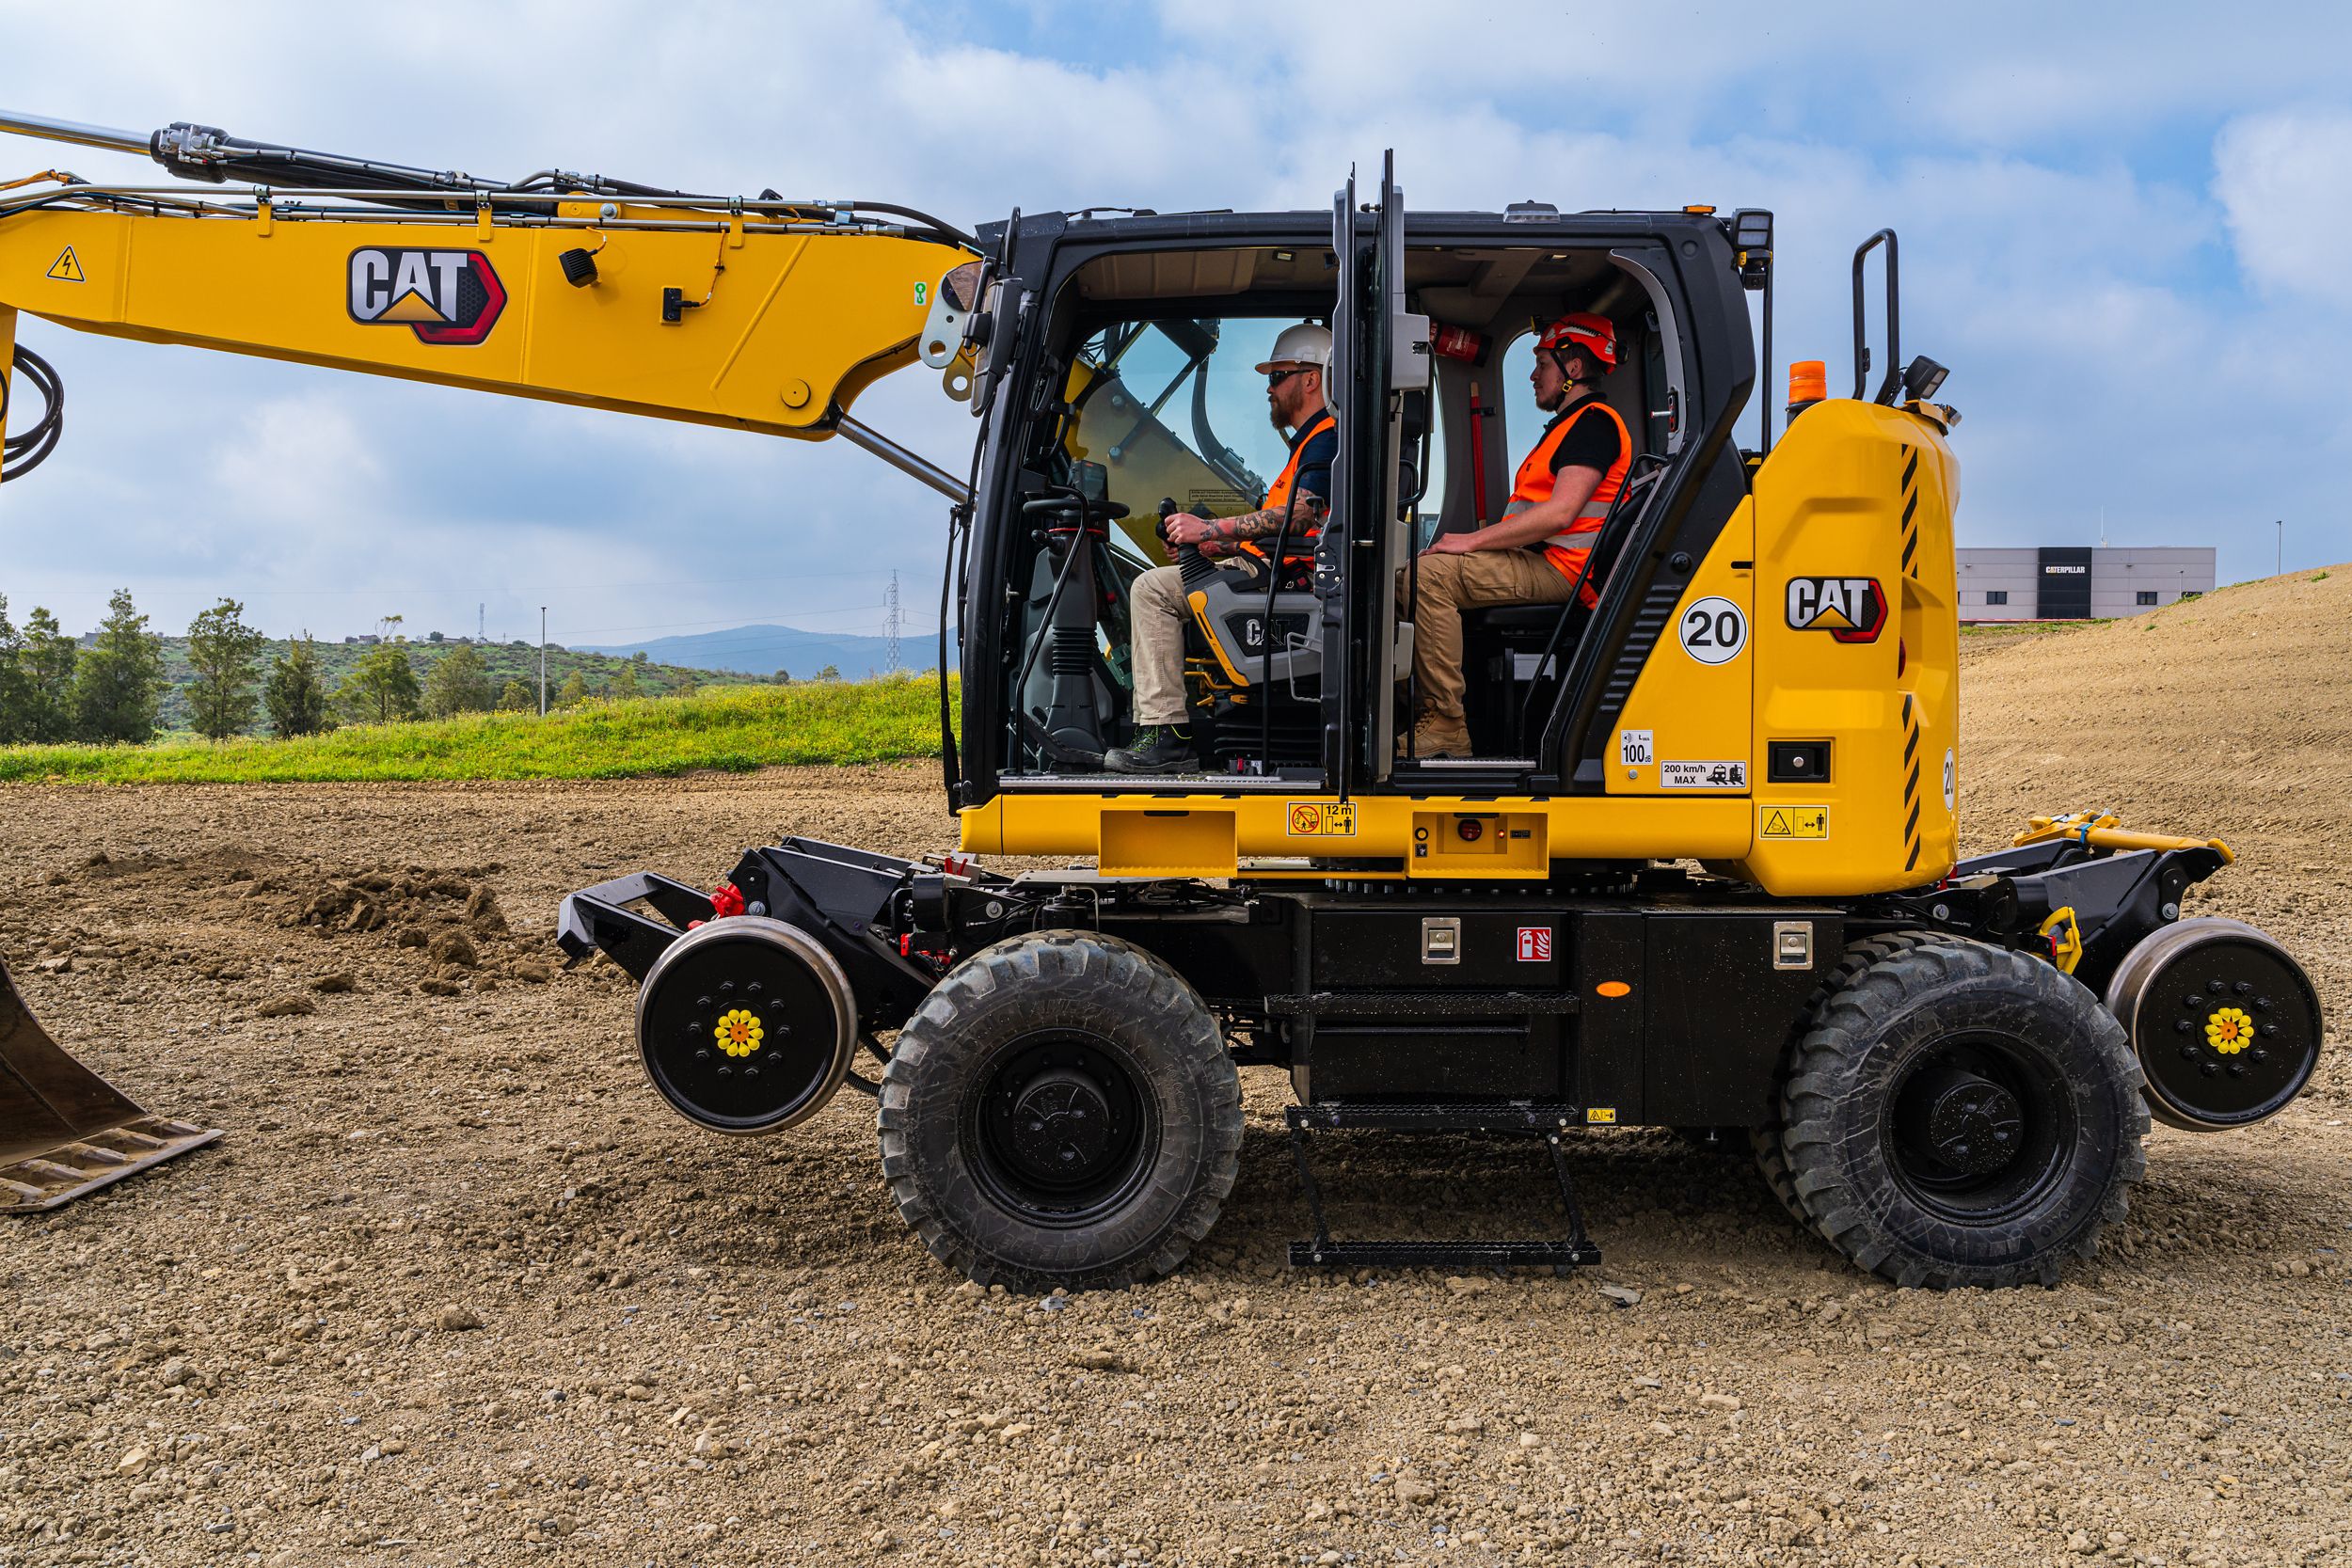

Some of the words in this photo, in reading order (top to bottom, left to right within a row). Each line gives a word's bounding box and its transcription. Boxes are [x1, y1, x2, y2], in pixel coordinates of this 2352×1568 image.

[352, 249, 468, 322] CAT
[2045, 565, 2086, 574] CATERPILLAR
[1788, 578, 1869, 628] CAT
[1687, 610, 1740, 648] 20
[1663, 764, 1681, 773] 200
[1683, 764, 1707, 773] km/h
[1674, 776, 1696, 784] MAX
[1945, 760, 1954, 796] 20
[1326, 804, 1339, 816] 12
[1341, 807, 1352, 816] m
